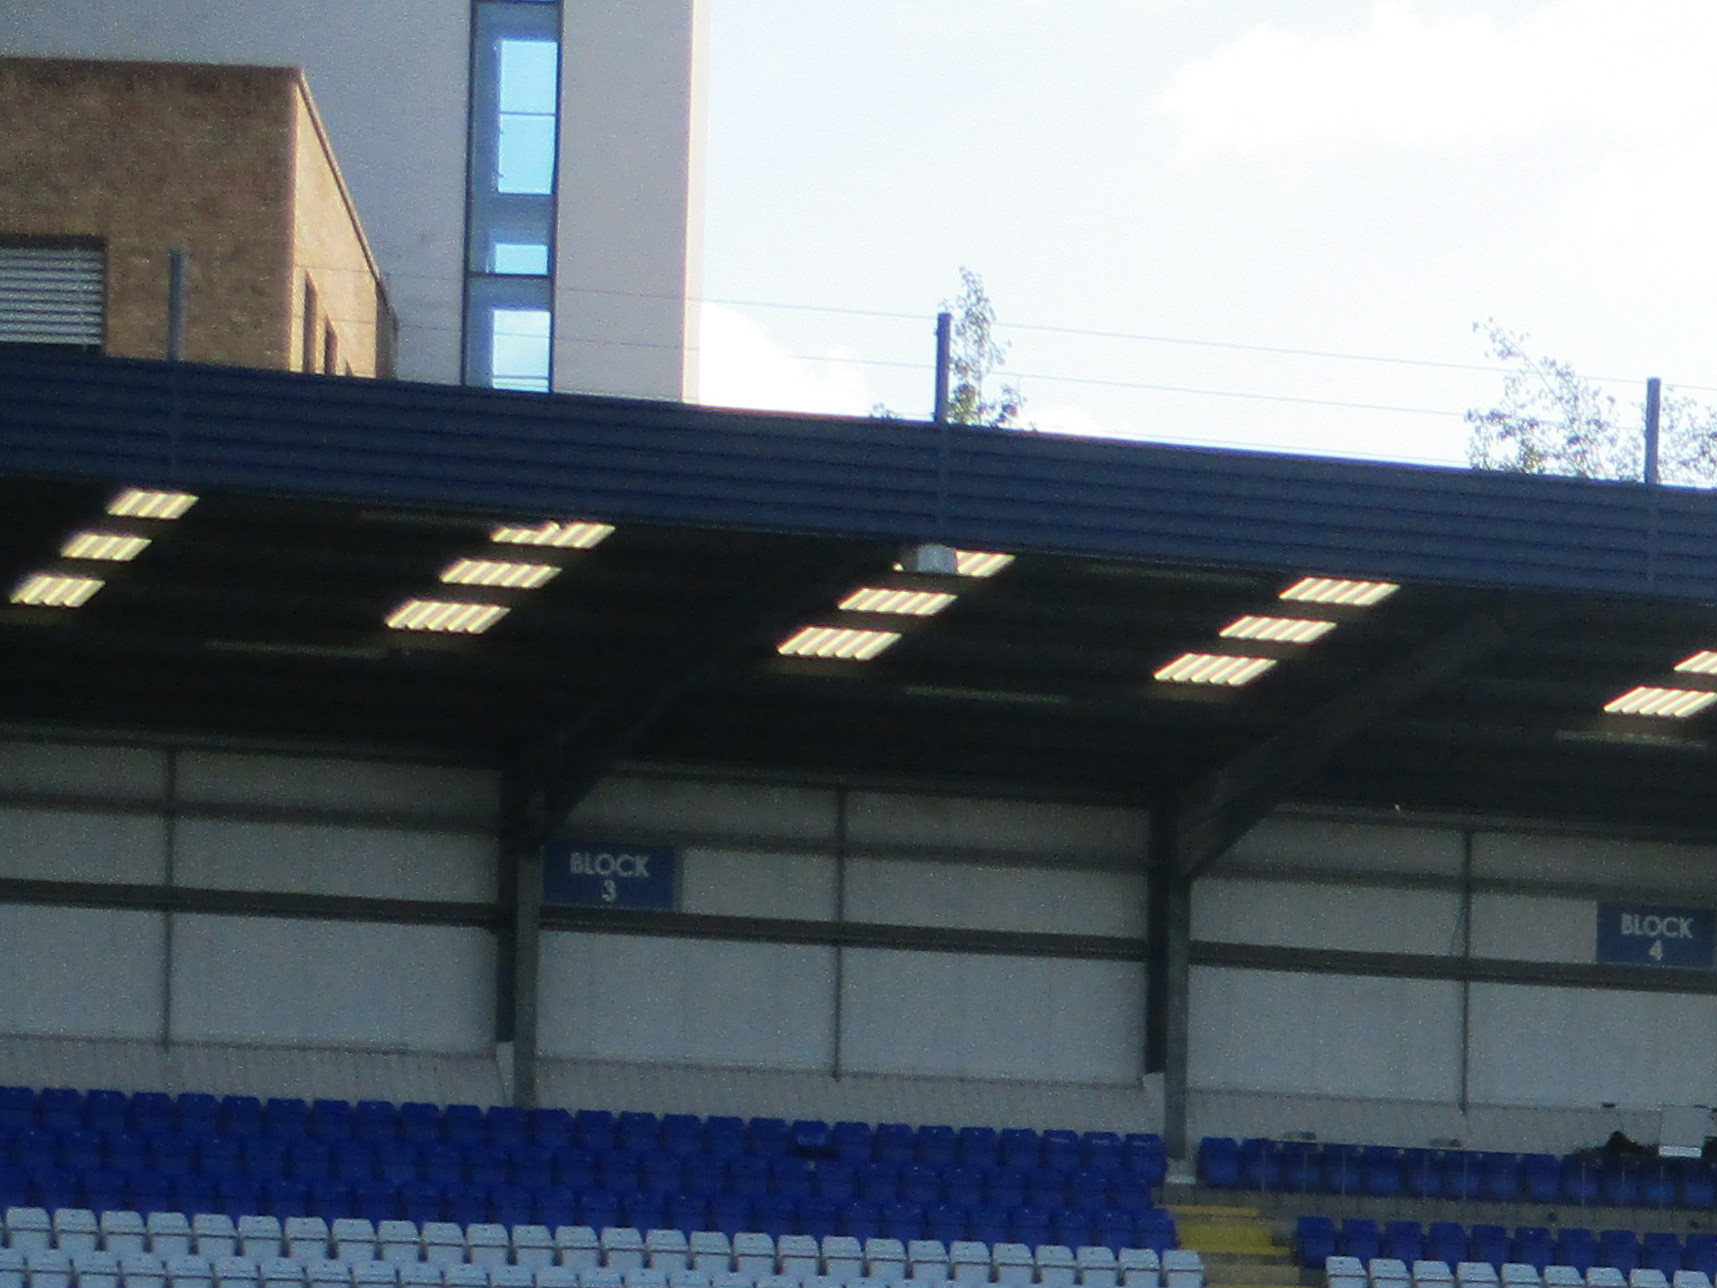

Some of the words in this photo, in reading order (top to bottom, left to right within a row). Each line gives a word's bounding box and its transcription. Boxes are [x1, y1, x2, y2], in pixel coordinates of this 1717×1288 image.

[570, 852, 649, 877] BLOCK
[601, 880, 617, 902] 3
[1622, 913, 1693, 939] BLOCK
[1648, 939, 1663, 961] 4
